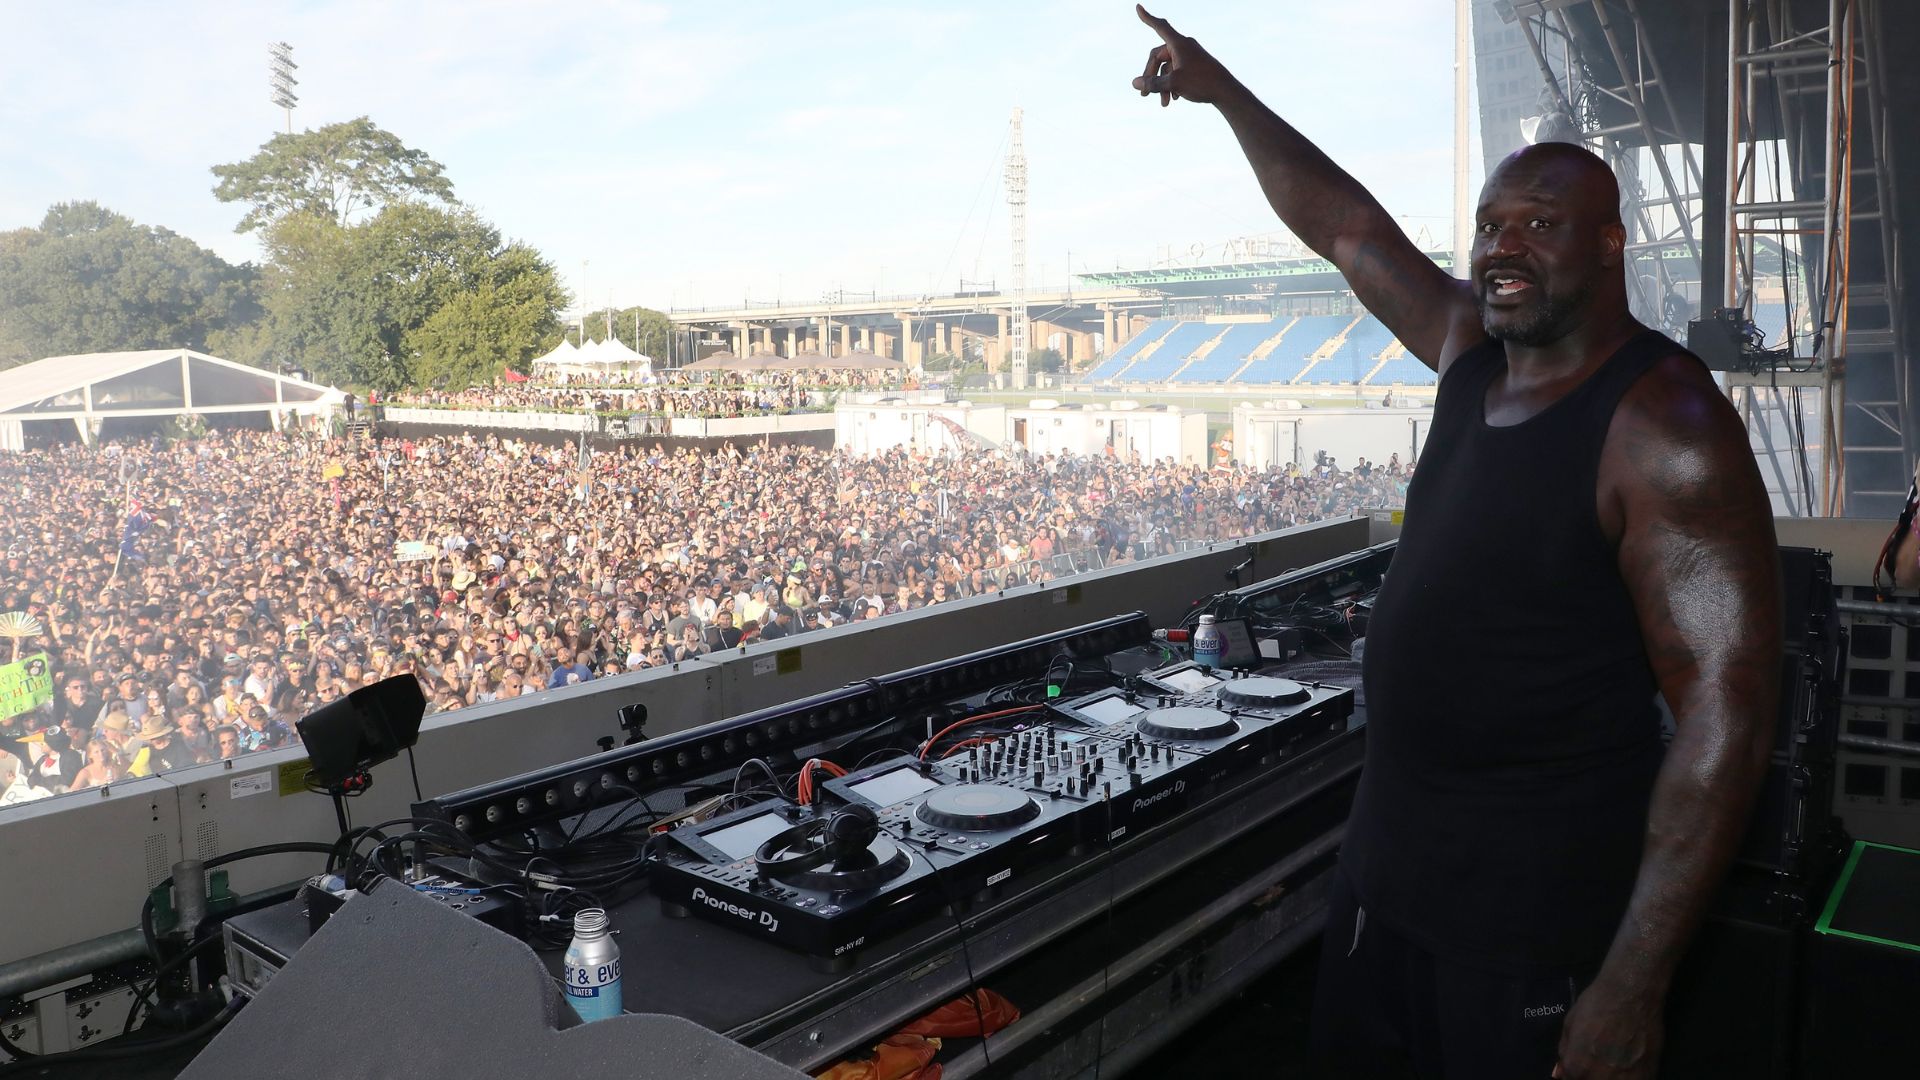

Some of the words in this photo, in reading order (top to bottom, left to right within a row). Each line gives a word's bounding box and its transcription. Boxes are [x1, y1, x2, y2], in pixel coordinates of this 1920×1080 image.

[1201, 640, 1217, 648] ever
[1132, 787, 1173, 812] Pioneer
[692, 887, 756, 920] Pioneer
[834, 940, 855, 955] SIR-NY
[578, 968, 590, 984] &
[597, 959, 620, 983] eve
[573, 988, 593, 997] WATER
[1524, 1003, 1565, 1018] Reebok
